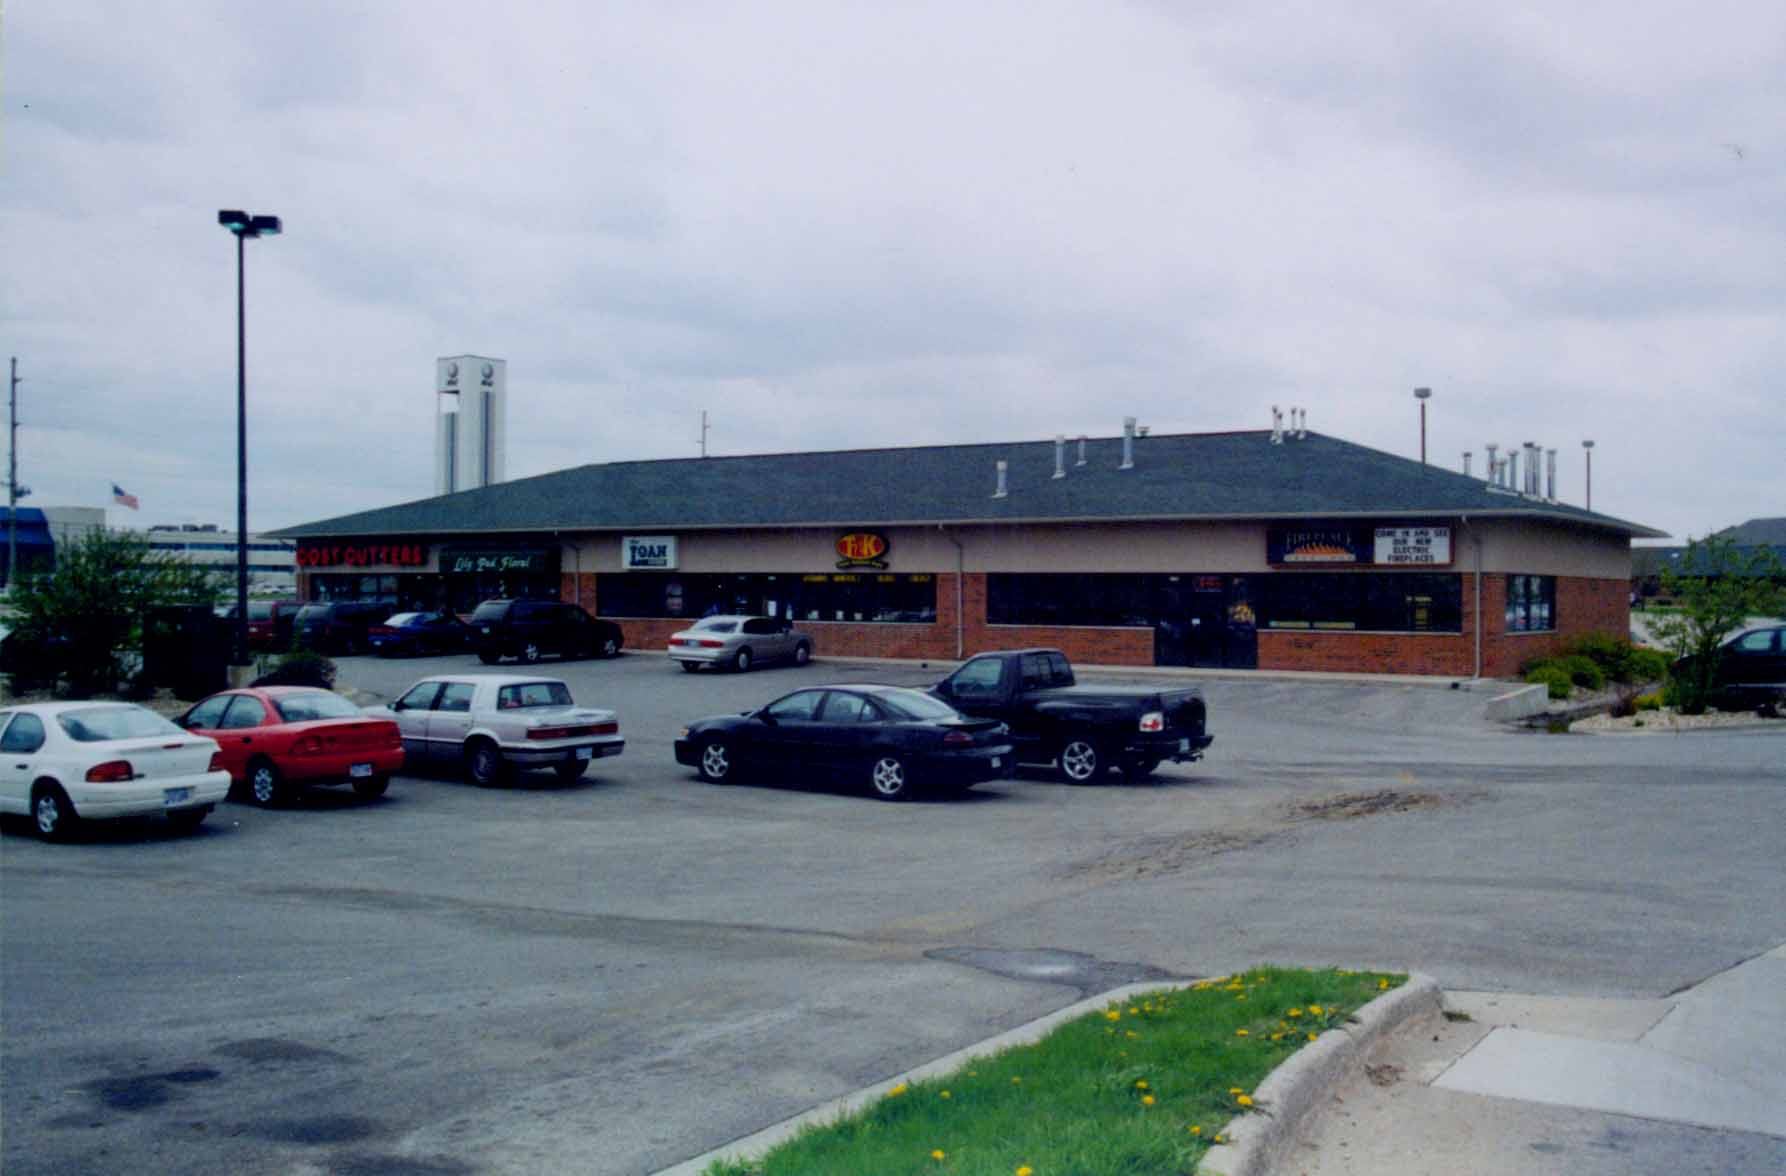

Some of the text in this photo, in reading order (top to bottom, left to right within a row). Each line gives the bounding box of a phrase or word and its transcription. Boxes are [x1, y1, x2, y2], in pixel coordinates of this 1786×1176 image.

[297, 544, 423, 567] COST CUTTERS
[1387, 554, 1434, 562] FIREPLACES
